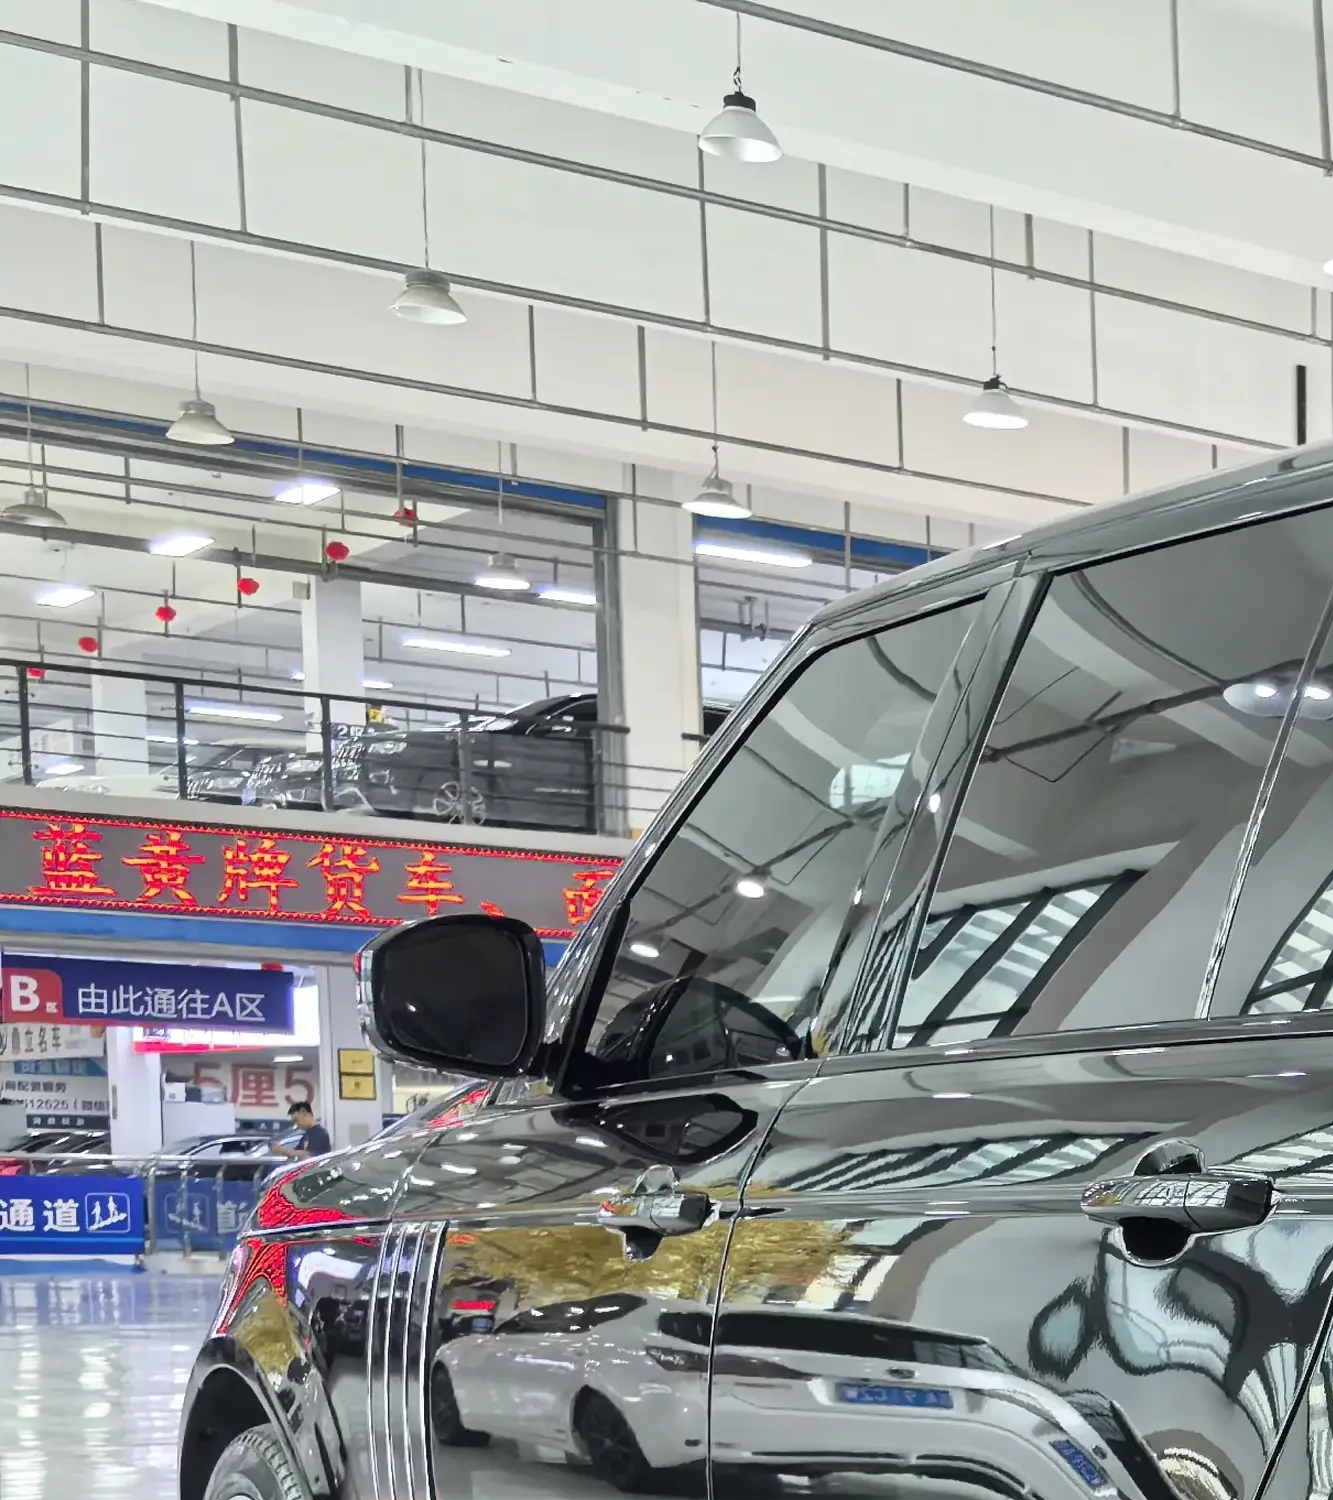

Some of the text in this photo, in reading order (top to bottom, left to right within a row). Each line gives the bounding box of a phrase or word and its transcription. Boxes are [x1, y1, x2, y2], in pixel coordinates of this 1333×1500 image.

[78, 983, 265, 1022] 由此通往A区
